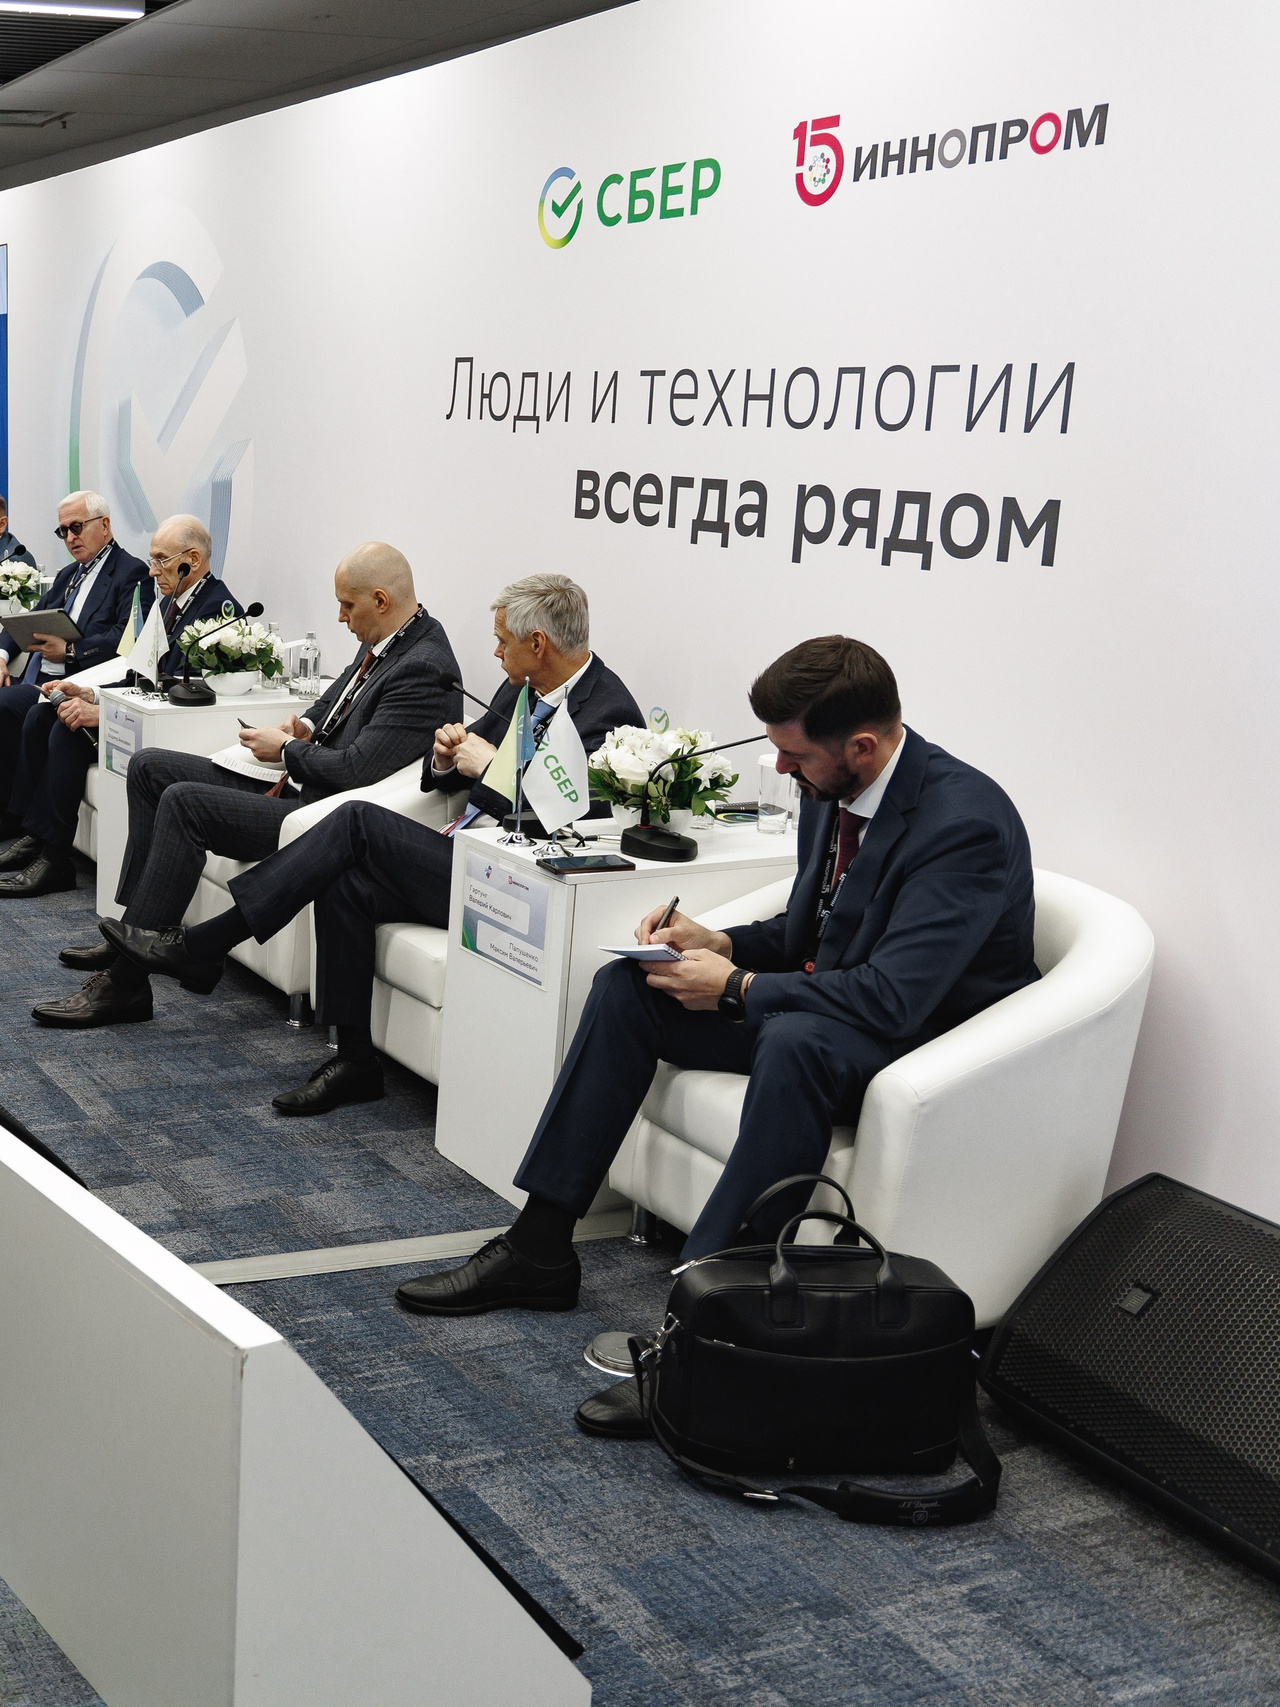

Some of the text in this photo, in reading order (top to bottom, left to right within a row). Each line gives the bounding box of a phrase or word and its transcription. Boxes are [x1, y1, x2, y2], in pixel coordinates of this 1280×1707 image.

[792, 102, 1110, 207] 15 ИННОПРОМ
[597, 157, 722, 227] СБЕР
[446, 356, 1077, 435] Люди и технологии
[574, 469, 1061, 571] всегда рядом
[544, 755, 579, 803] СБЕР
[469, 895, 512, 920] Валерий Карлович
[489, 943, 538, 972] Максим Валерьевич
